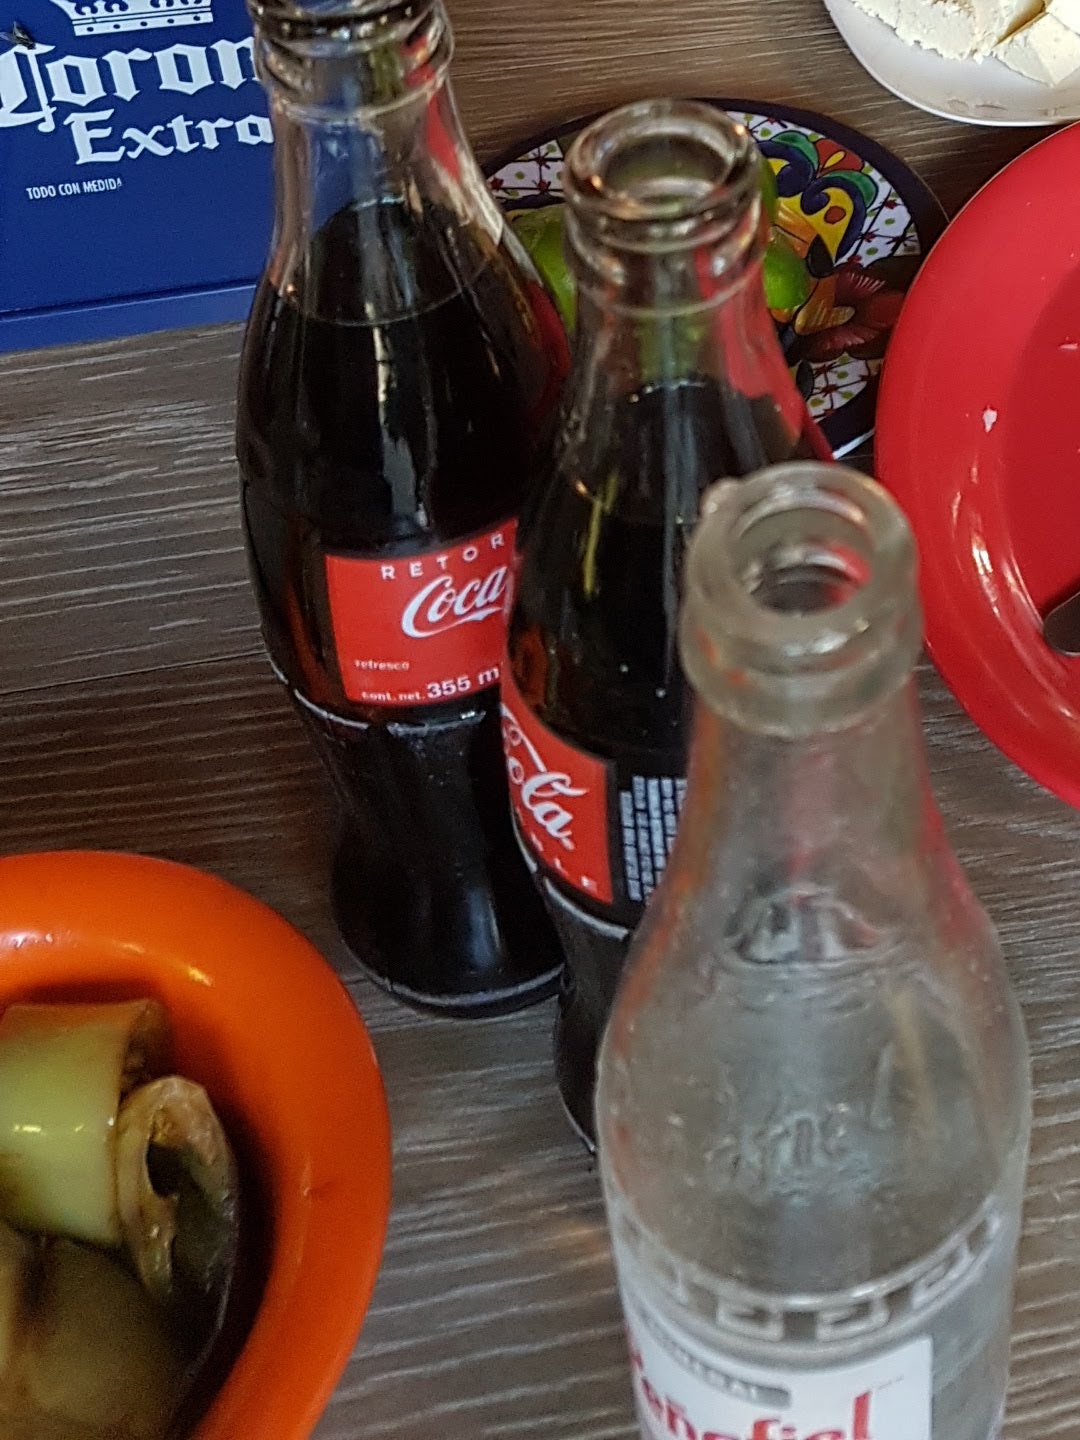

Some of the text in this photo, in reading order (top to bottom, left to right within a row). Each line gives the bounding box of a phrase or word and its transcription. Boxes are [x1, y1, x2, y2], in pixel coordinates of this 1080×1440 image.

[0, 36, 263, 133] Coron
[63, 108, 275, 165] Extra
[26, 184, 57, 200] TODO
[58, 181, 81, 197] CON
[380, 532, 505, 580] RETOR
[426, 674, 472, 699] 355
[477, 665, 501, 686] m
